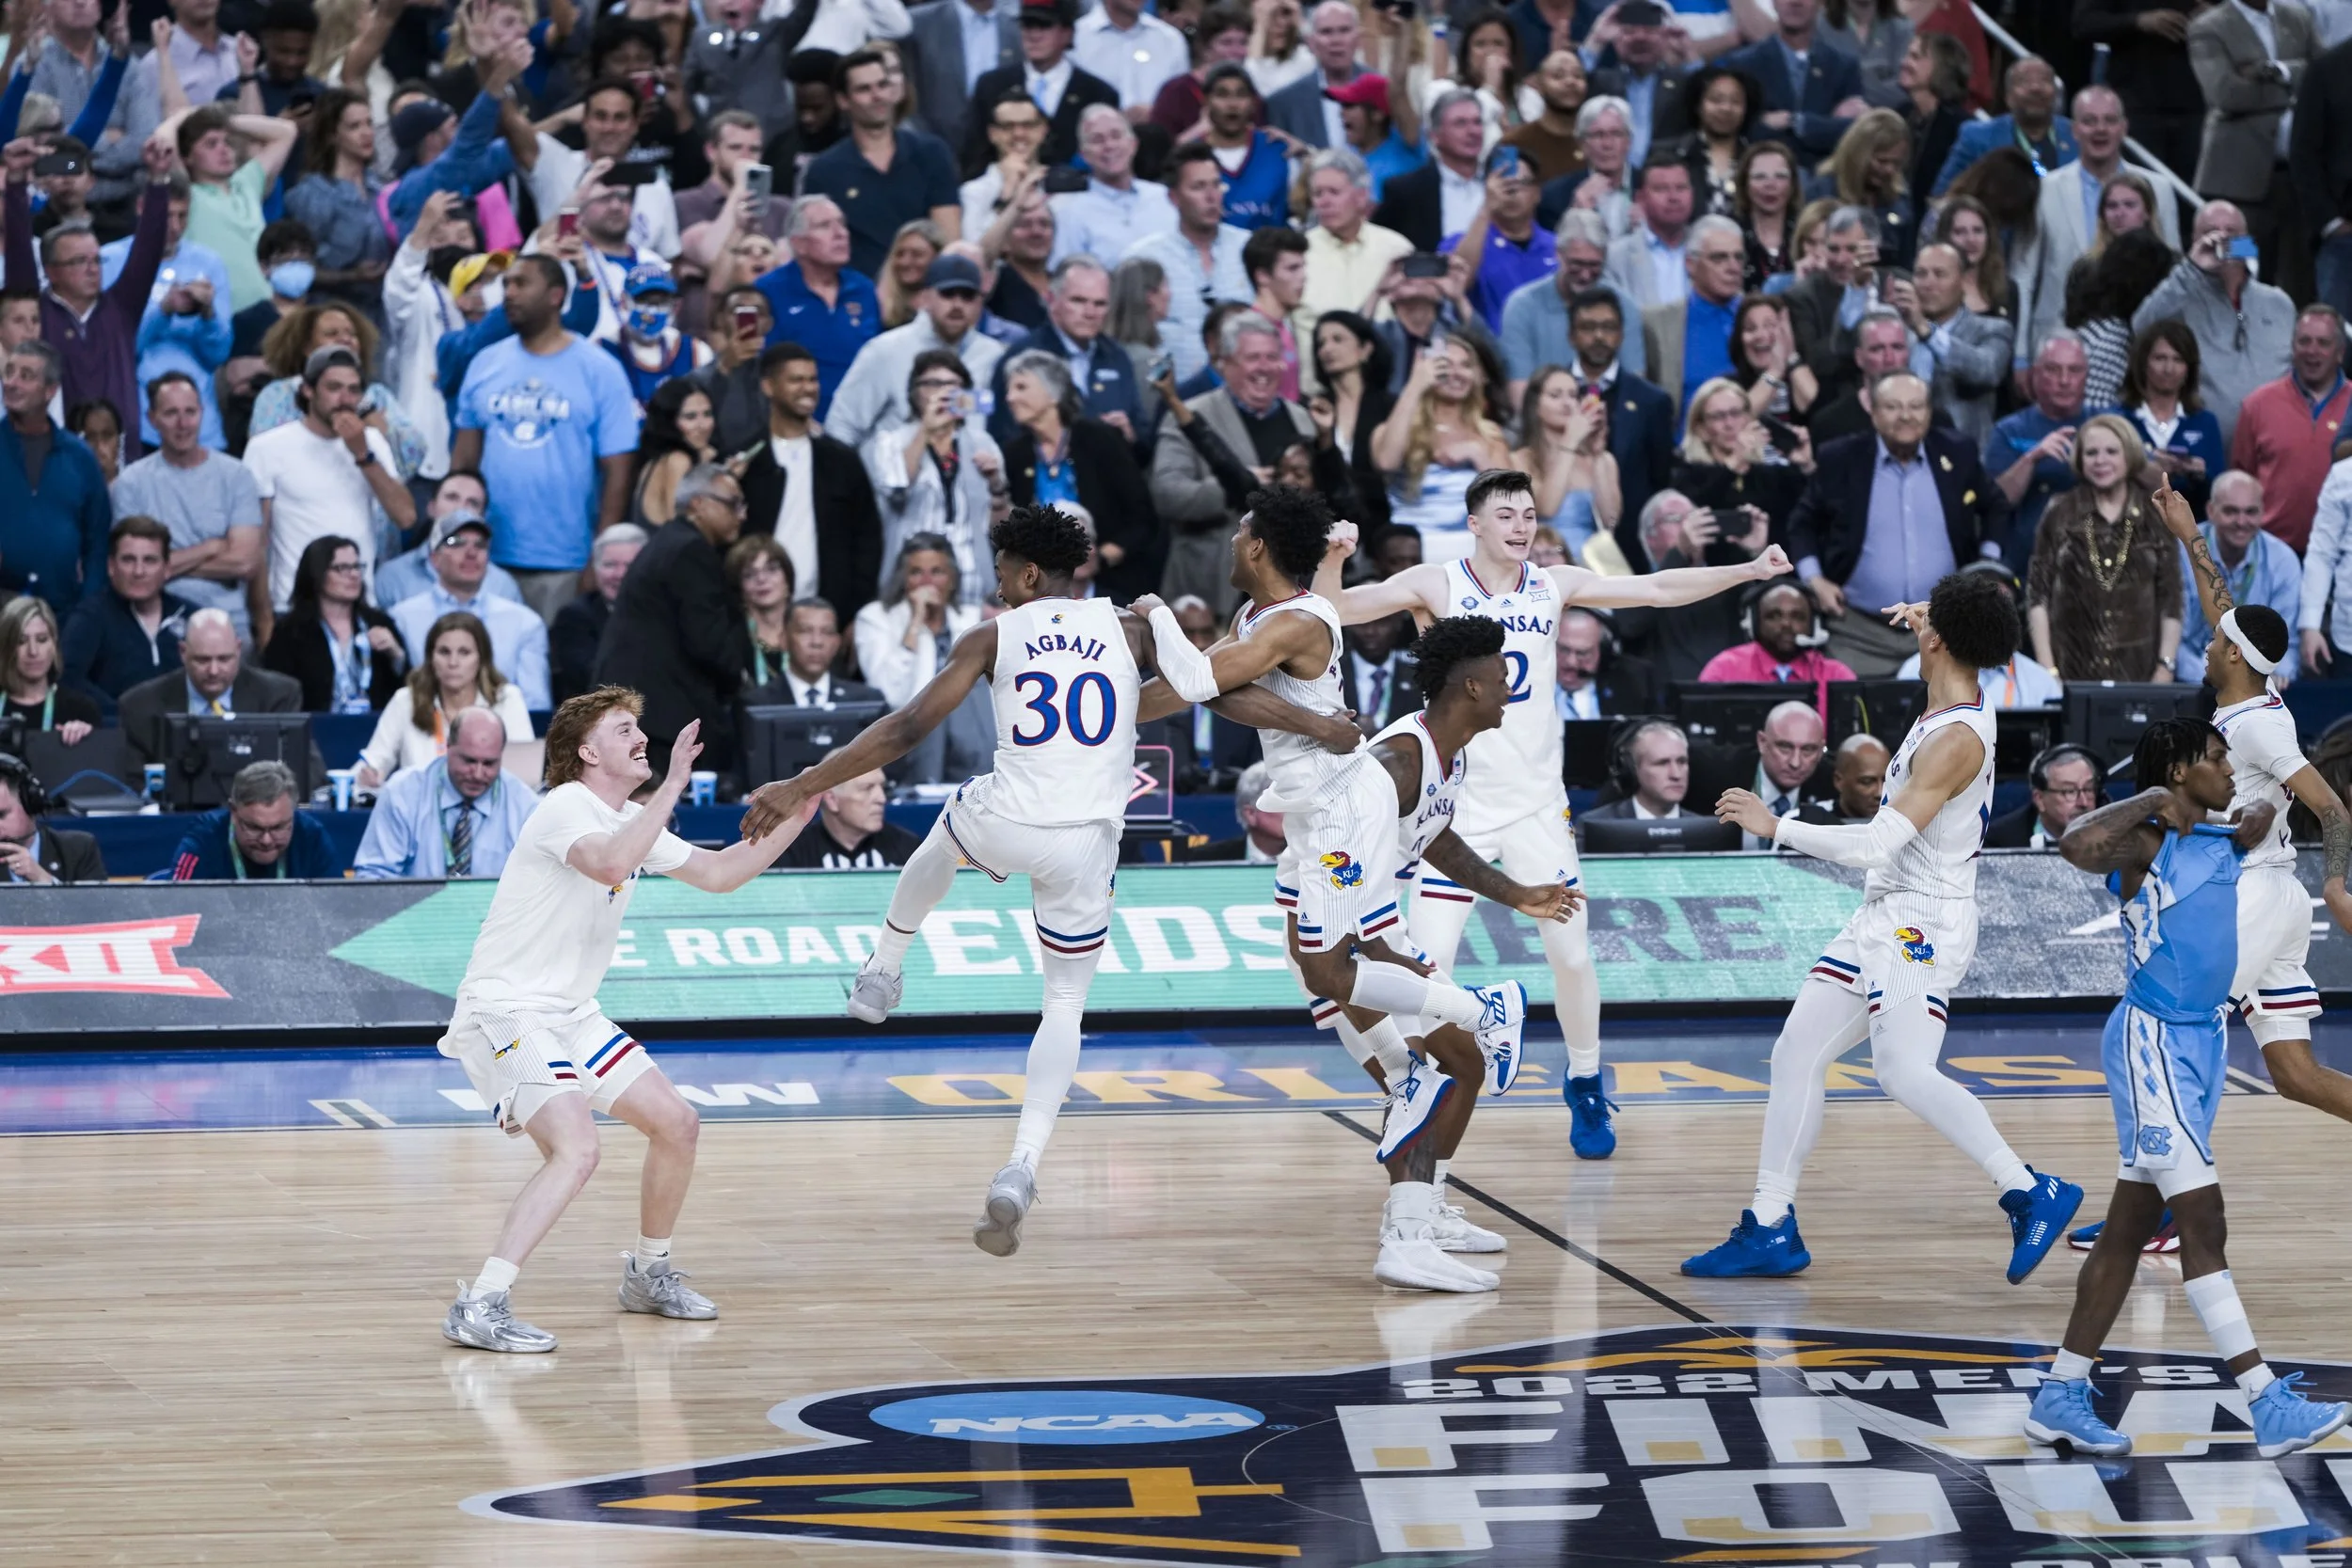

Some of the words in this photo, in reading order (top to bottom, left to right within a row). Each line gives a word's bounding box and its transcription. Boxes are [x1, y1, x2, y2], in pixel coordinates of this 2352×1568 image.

[1500, 615, 1552, 636] NSAS
[1025, 634, 1106, 661] AGBAJI
[1012, 671, 1117, 747] 30
[1415, 798, 1455, 830] KANSA
[665, 925, 882, 967] ROAD
[1454, 895, 1787, 965] ERE
[1914, 946, 1926, 956] KU
[1402, 1372, 1757, 1399] 2022
[929, 1413, 1261, 1433] NCAA
[1360, 1460, 2352, 1553] FOU
